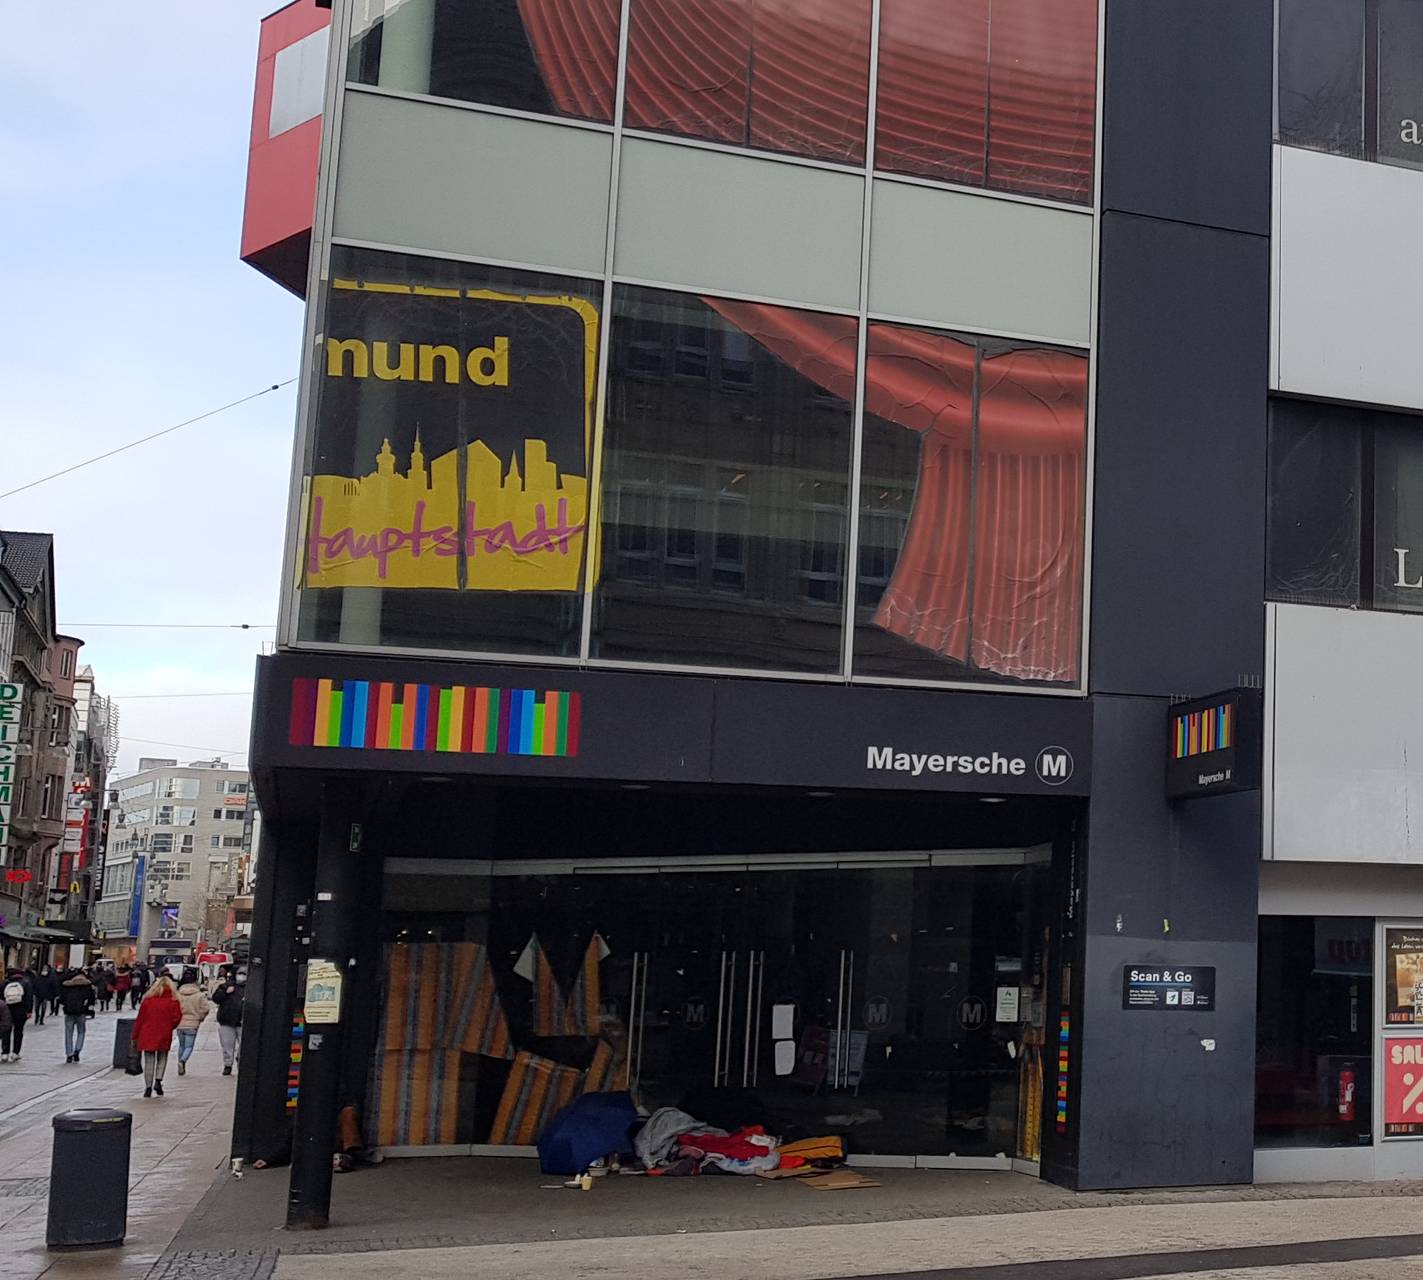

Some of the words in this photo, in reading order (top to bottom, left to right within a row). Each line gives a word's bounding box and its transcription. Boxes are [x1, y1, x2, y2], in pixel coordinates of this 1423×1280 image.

[866, 746, 1026, 776] Mayersche
[1130, 970, 1160, 982] Scan
[1162, 970, 1172, 982] &
[1174, 971, 1192, 982] Go
